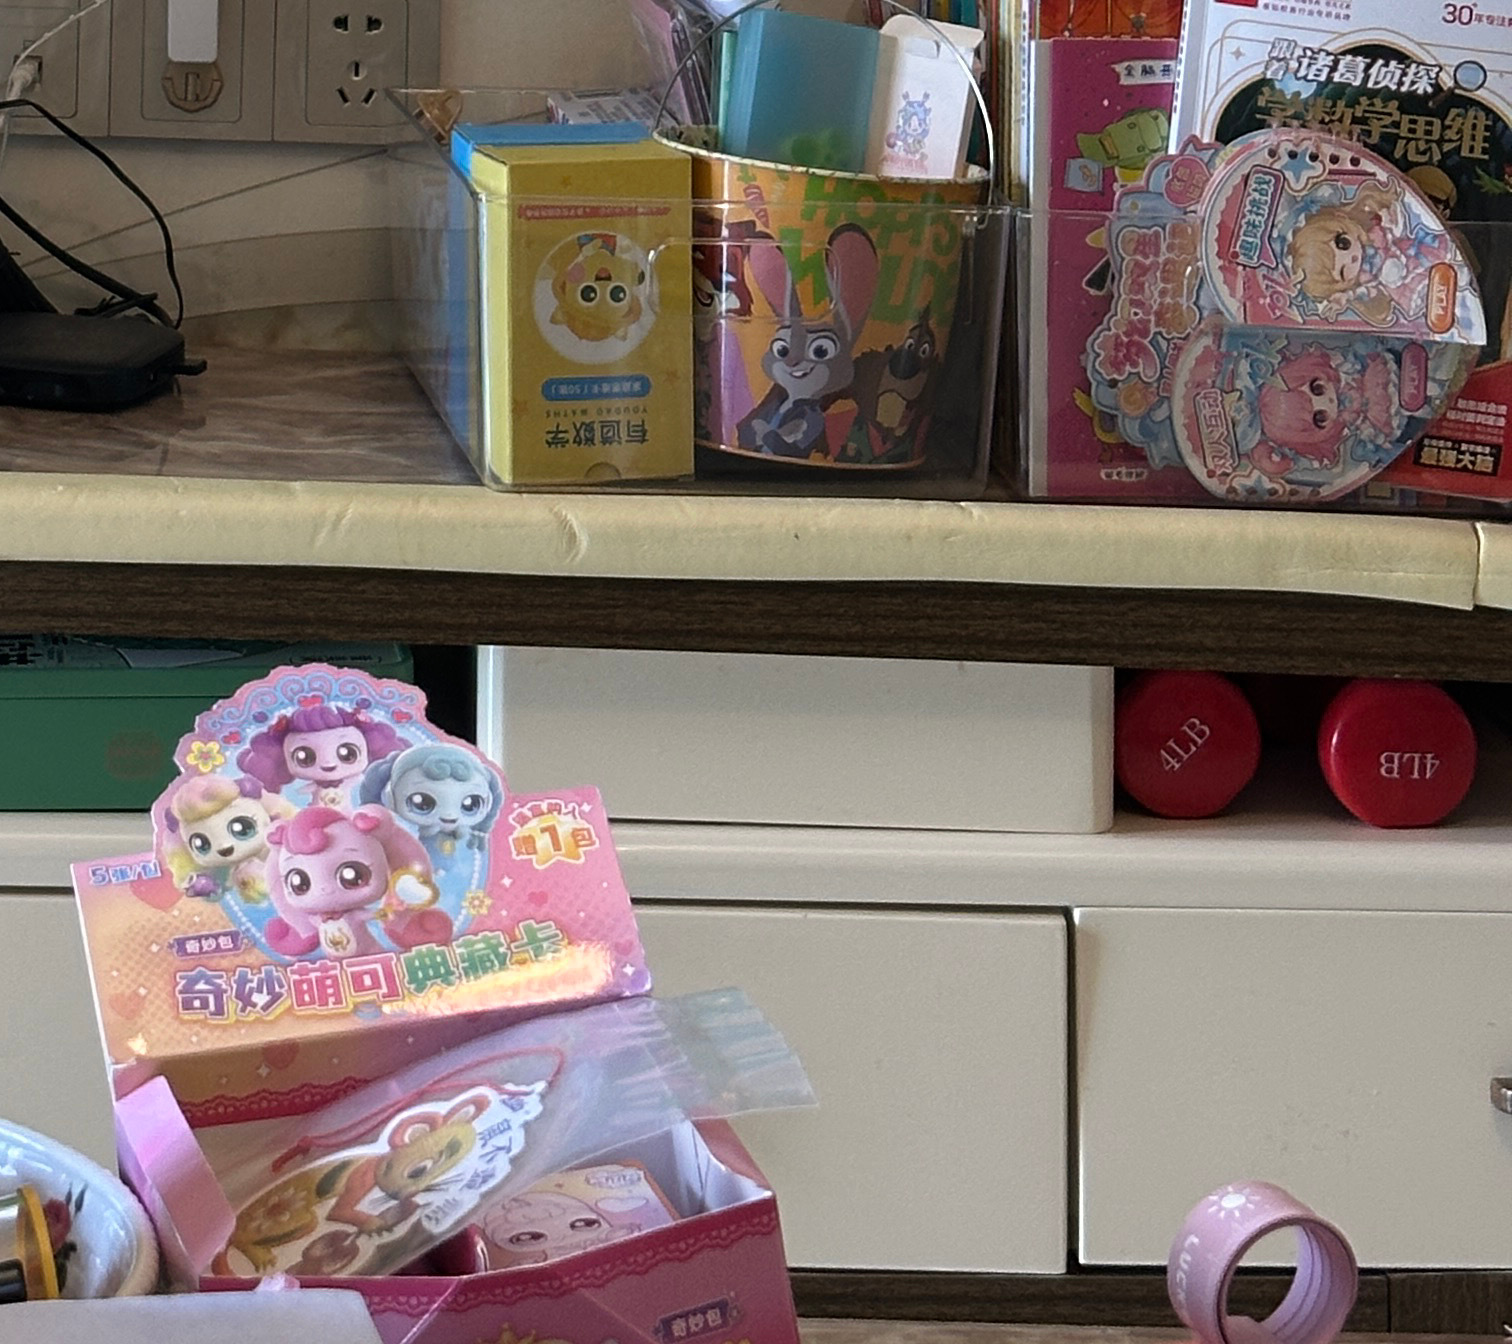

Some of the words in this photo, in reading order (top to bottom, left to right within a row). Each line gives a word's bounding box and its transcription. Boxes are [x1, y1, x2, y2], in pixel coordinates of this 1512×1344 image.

[1295, 47, 1441, 96] 诸葛侦探
[1239, 171, 1276, 262] 趣味挑战
[1434, 279, 1448, 317] PLAY
[545, 408, 588, 419] MATHS
[596, 405, 649, 416] YOUDAO
[545, 419, 650, 449] 有道数学
[1195, 390, 1234, 467] 双人互动
[1158, 715, 1212, 775] 4LB
[1378, 750, 1441, 780] 4LB
[184, 934, 235, 954] 奇妙包
[174, 918, 570, 1019] 奇妙萌可典藏卡
[671, 1307, 722, 1337] 奇妙包
